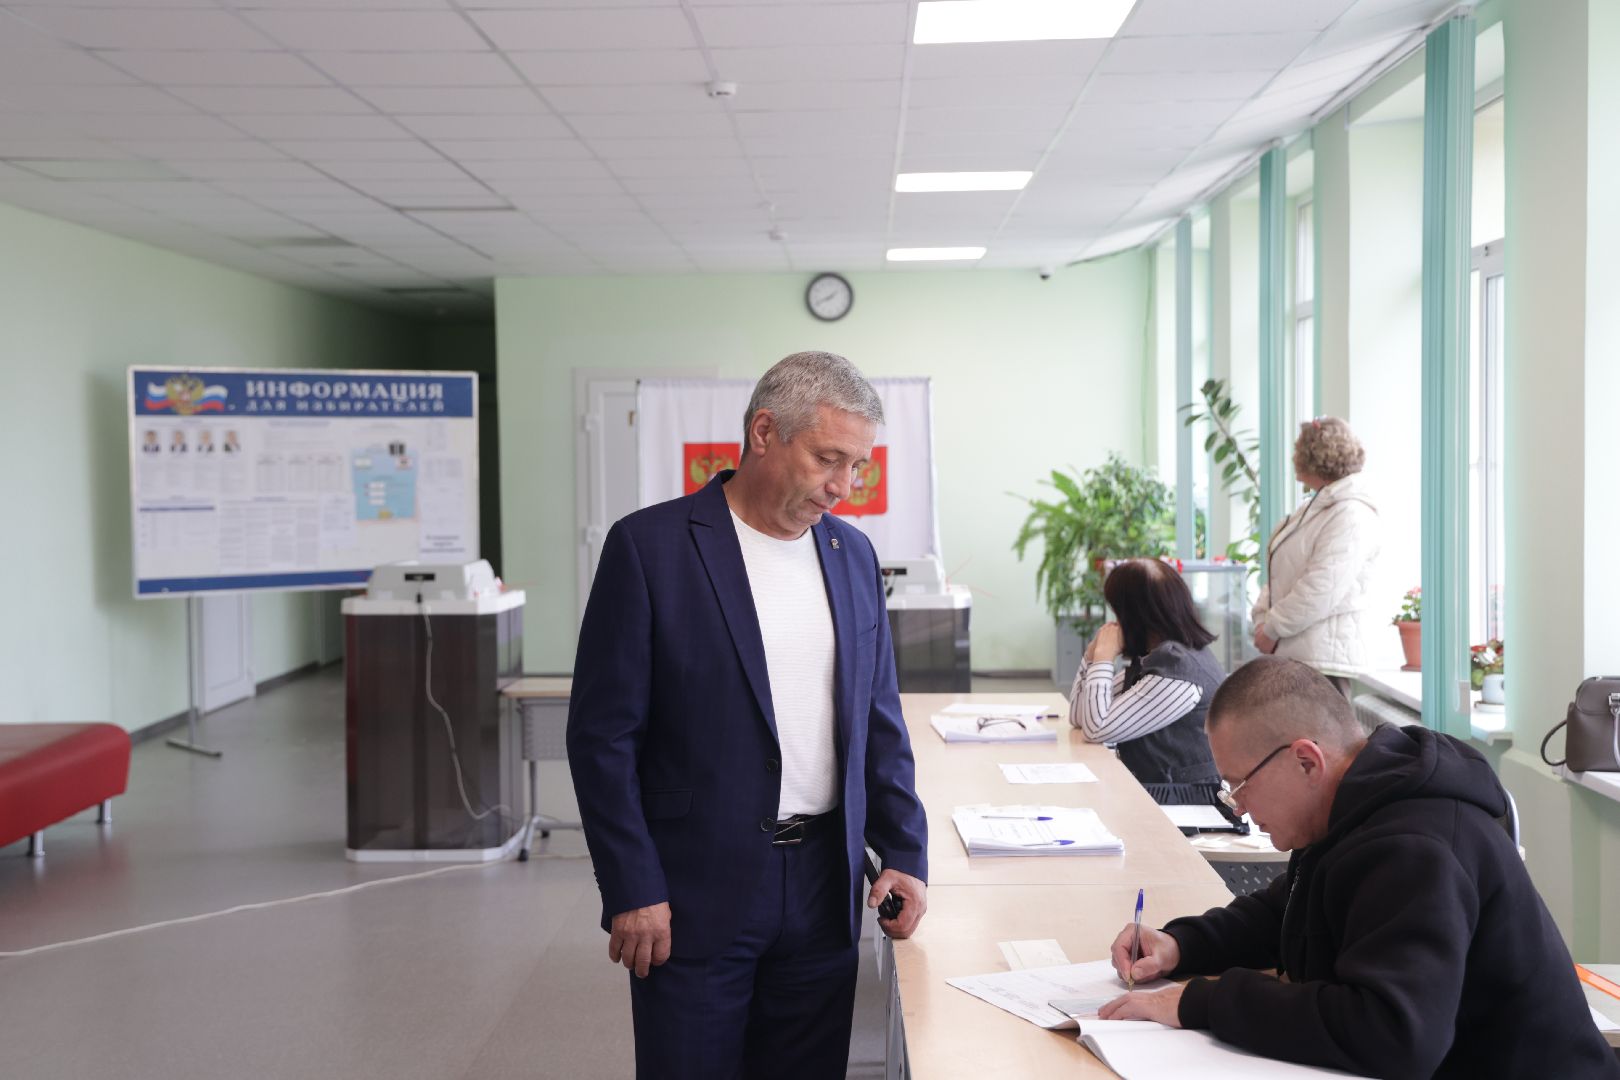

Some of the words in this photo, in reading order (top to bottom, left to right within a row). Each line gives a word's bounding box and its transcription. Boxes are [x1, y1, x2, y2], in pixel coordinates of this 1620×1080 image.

[246, 380, 443, 402] ИНФОРМАЦИЯ
[246, 400, 287, 412] ДЛЯ
[296, 400, 444, 413] ИЗБИРАТЕЛЕЙ
